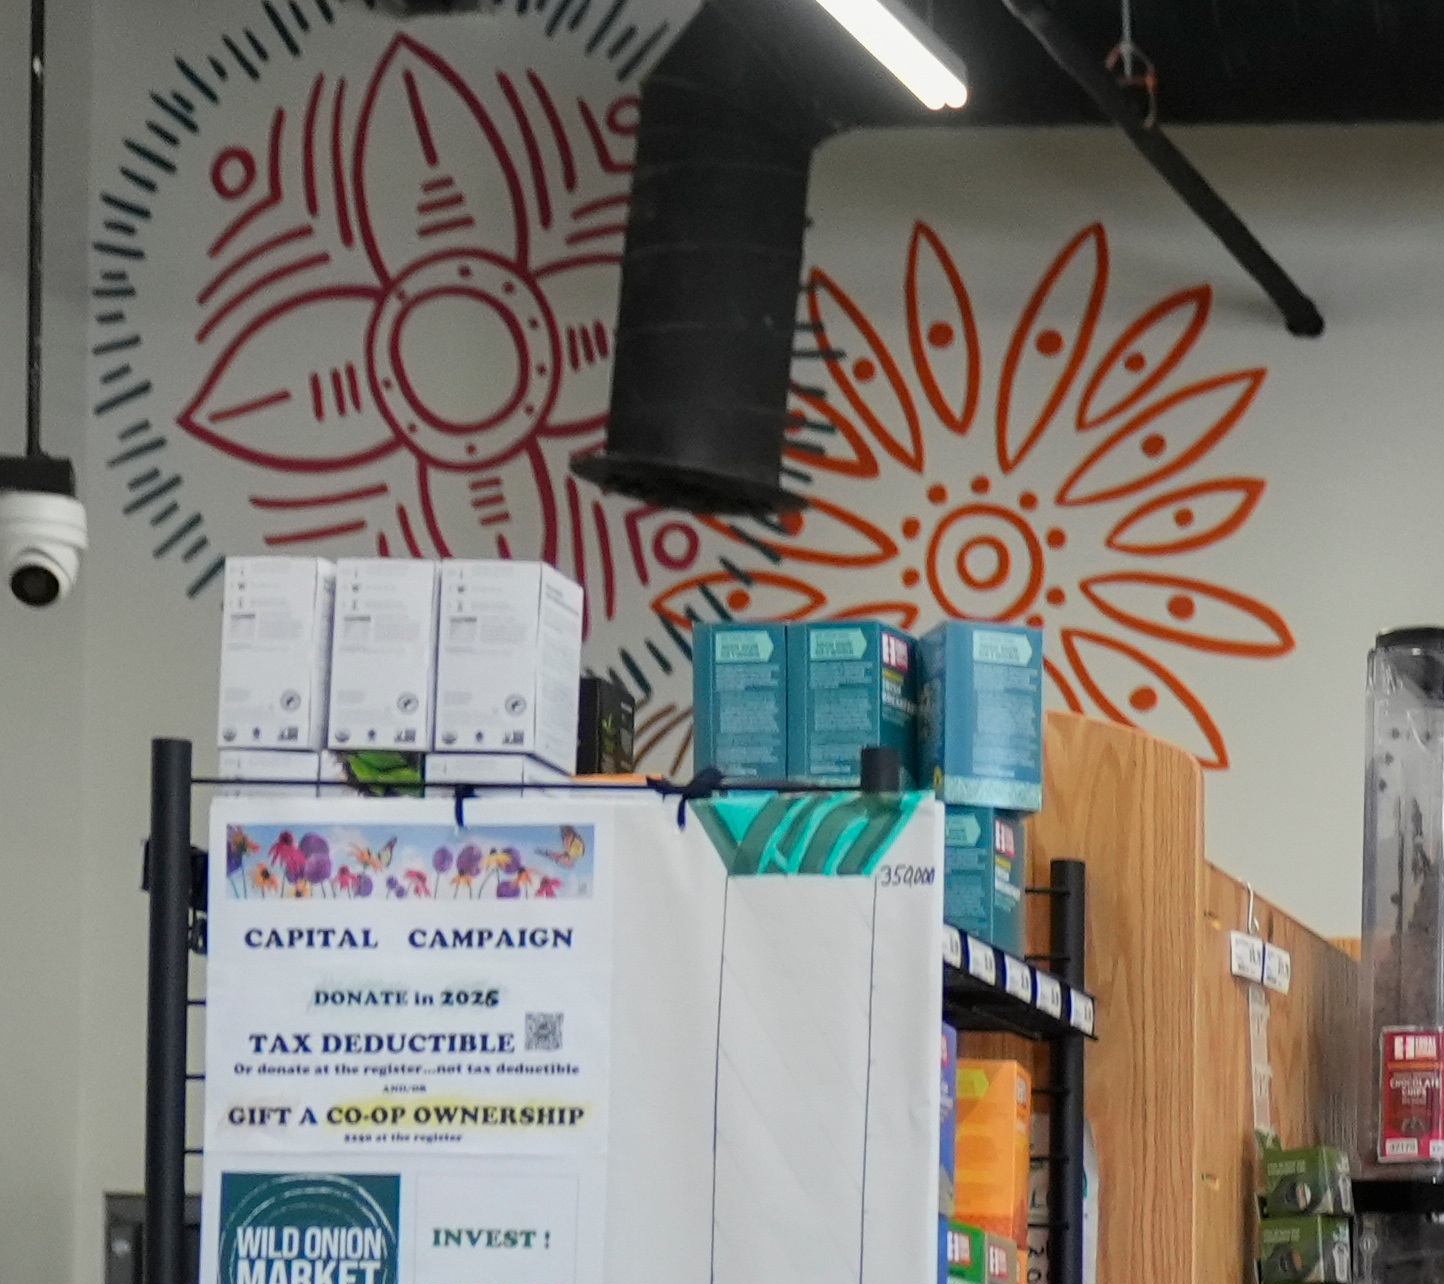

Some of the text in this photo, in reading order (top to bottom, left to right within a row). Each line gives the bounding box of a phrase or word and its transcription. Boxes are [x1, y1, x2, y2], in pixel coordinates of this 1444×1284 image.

[245, 929, 573, 948] CAPITAL CAMPAIGN
[314, 990, 408, 1006] DONATE
[414, 989, 433, 1005] in
[249, 1034, 514, 1053] TAX DEDUCTIBLE
[234, 1064, 252, 1075] Or
[258, 1064, 309, 1075] donate
[315, 1066, 329, 1075] at
[335, 1064, 358, 1075] the
[468, 1064, 491, 1075] tax
[497, 1064, 579, 1075] deductible
[228, 1107, 584, 1126] GIFT A CO-OP OWNERSHIP
[236, 1227, 381, 1260] WILD ONION
[432, 1228, 537, 1249] INVEST
